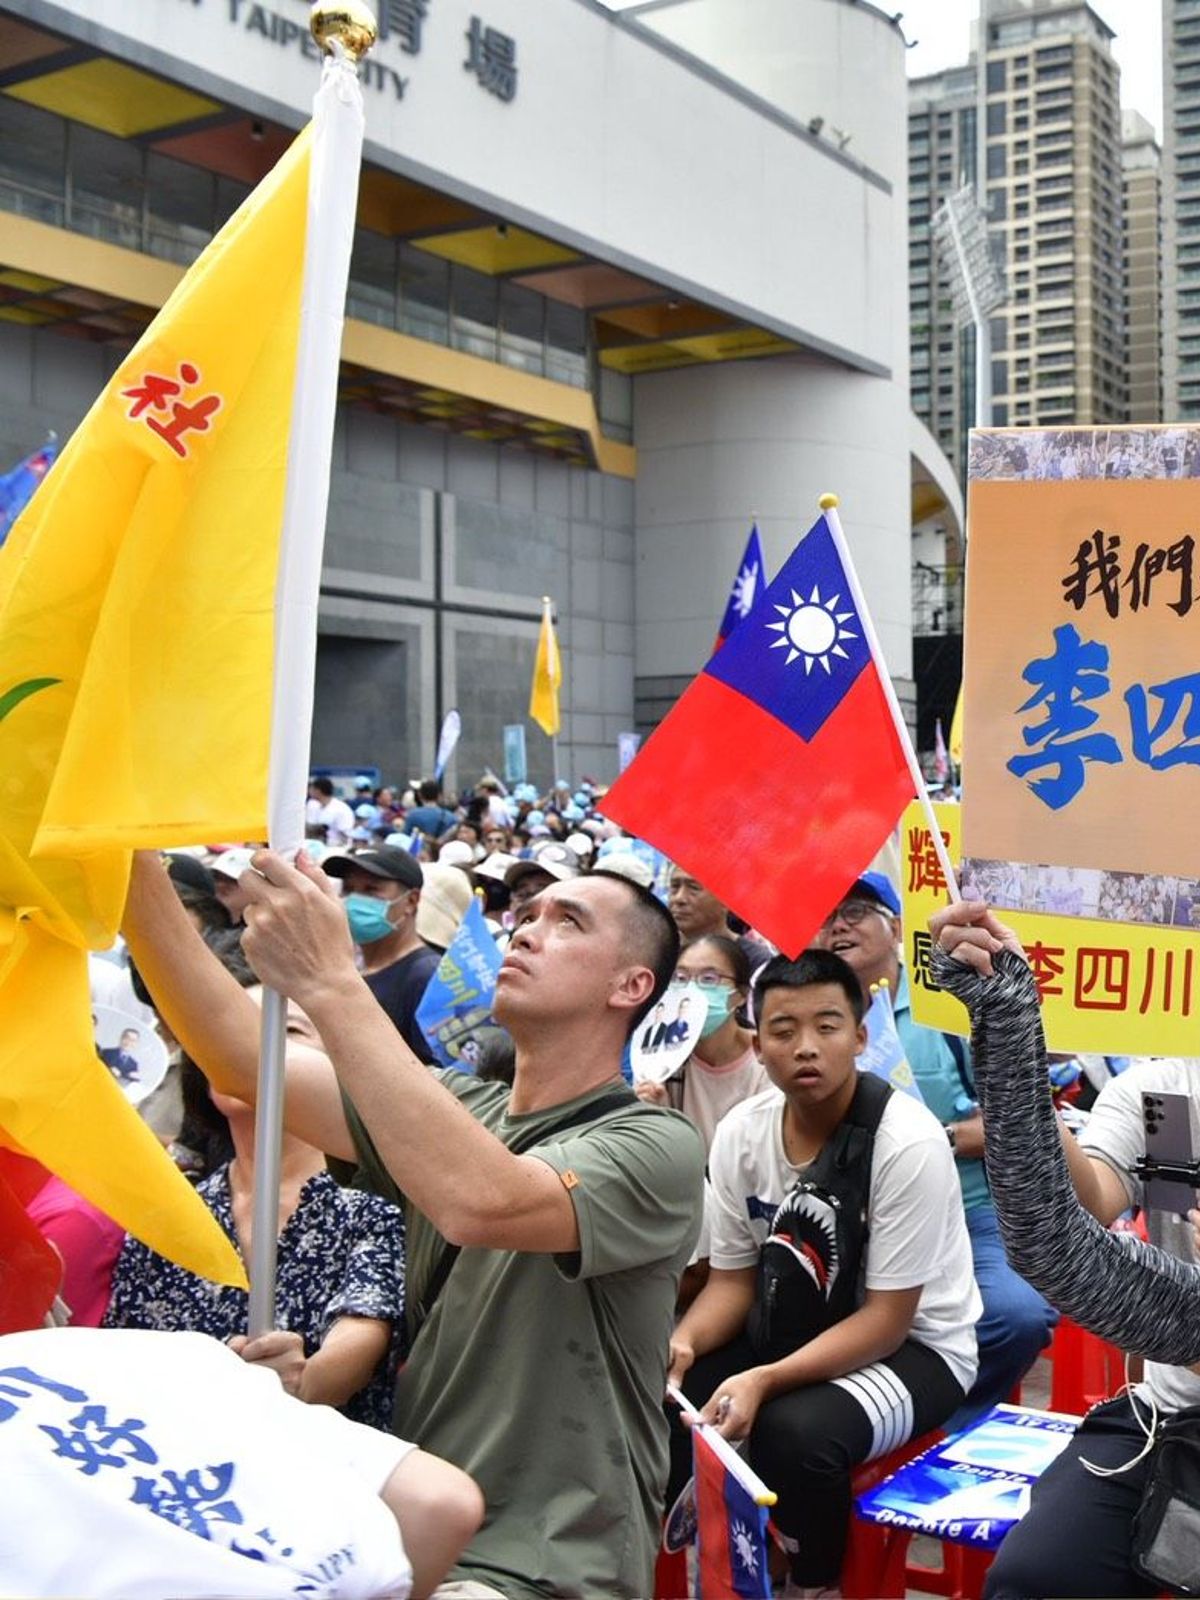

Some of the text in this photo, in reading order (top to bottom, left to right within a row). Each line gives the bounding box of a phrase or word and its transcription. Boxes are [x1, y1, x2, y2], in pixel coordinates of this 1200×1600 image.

[357, 57, 409, 101] ITY
[121, 363, 221, 458] 社
[970, 1520, 992, 1541] A
